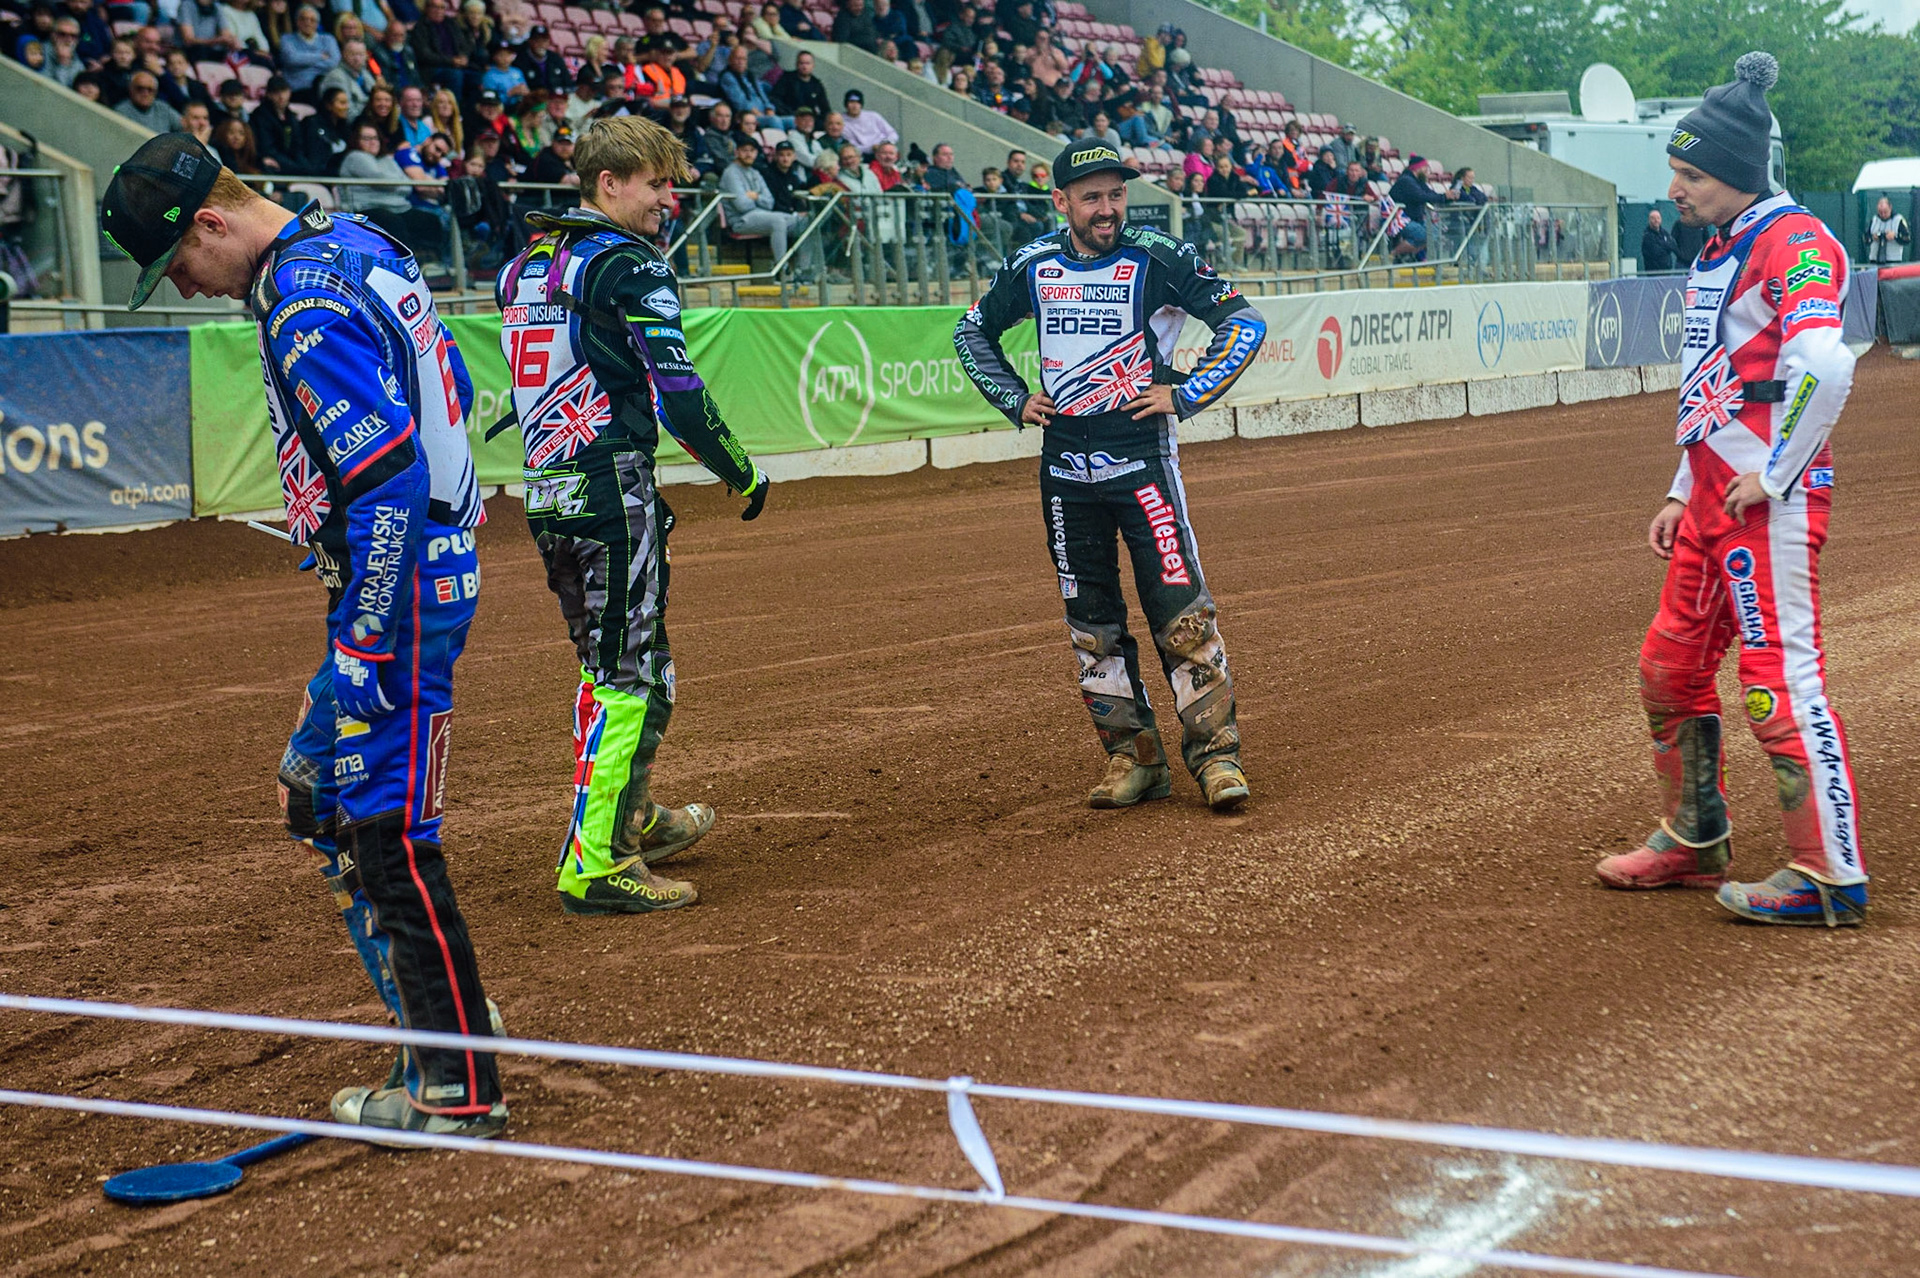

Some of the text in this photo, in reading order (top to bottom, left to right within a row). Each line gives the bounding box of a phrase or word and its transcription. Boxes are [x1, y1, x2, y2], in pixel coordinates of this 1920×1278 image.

[1042, 268, 1060, 278] SCB
[1112, 264, 1136, 281] 13
[1787, 265, 1816, 288] ROCK
[403, 296, 419, 318] SCB
[1040, 286, 1128, 302] SPORTS INSURE
[529, 304, 566, 323] INSURE
[1046, 307, 1123, 317] BRITISH FINAL
[1664, 312, 1682, 335] ATPI
[1046, 317, 1123, 336] 2022
[1350, 308, 1453, 347] DIRECT ATPI
[1481, 323, 1501, 345] ATPI
[1505, 318, 1580, 343] MARINE & ENERGY
[1600, 316, 1619, 340] ATPI
[511, 328, 555, 388] 16
[958, 346, 1001, 397] Warren
[1350, 352, 1413, 377] GLOBAL TRAVEL
[810, 361, 863, 404] ATPI
[879, 357, 967, 400] SPORTS
[1070, 367, 1148, 415] BRITISH FINAL
[531, 426, 570, 467] BRITISH
[568, 403, 606, 429] FINAL
[110, 481, 191, 511] atpi.com
[294, 485, 324, 514] FINAL
[1050, 495, 1069, 573] silkolene
[1136, 484, 1191, 586] milesey
[357, 505, 394, 612] KRAJEWSKI
[374, 506, 411, 617] KONSTRUKCJE
[607, 874, 681, 901] daytona
